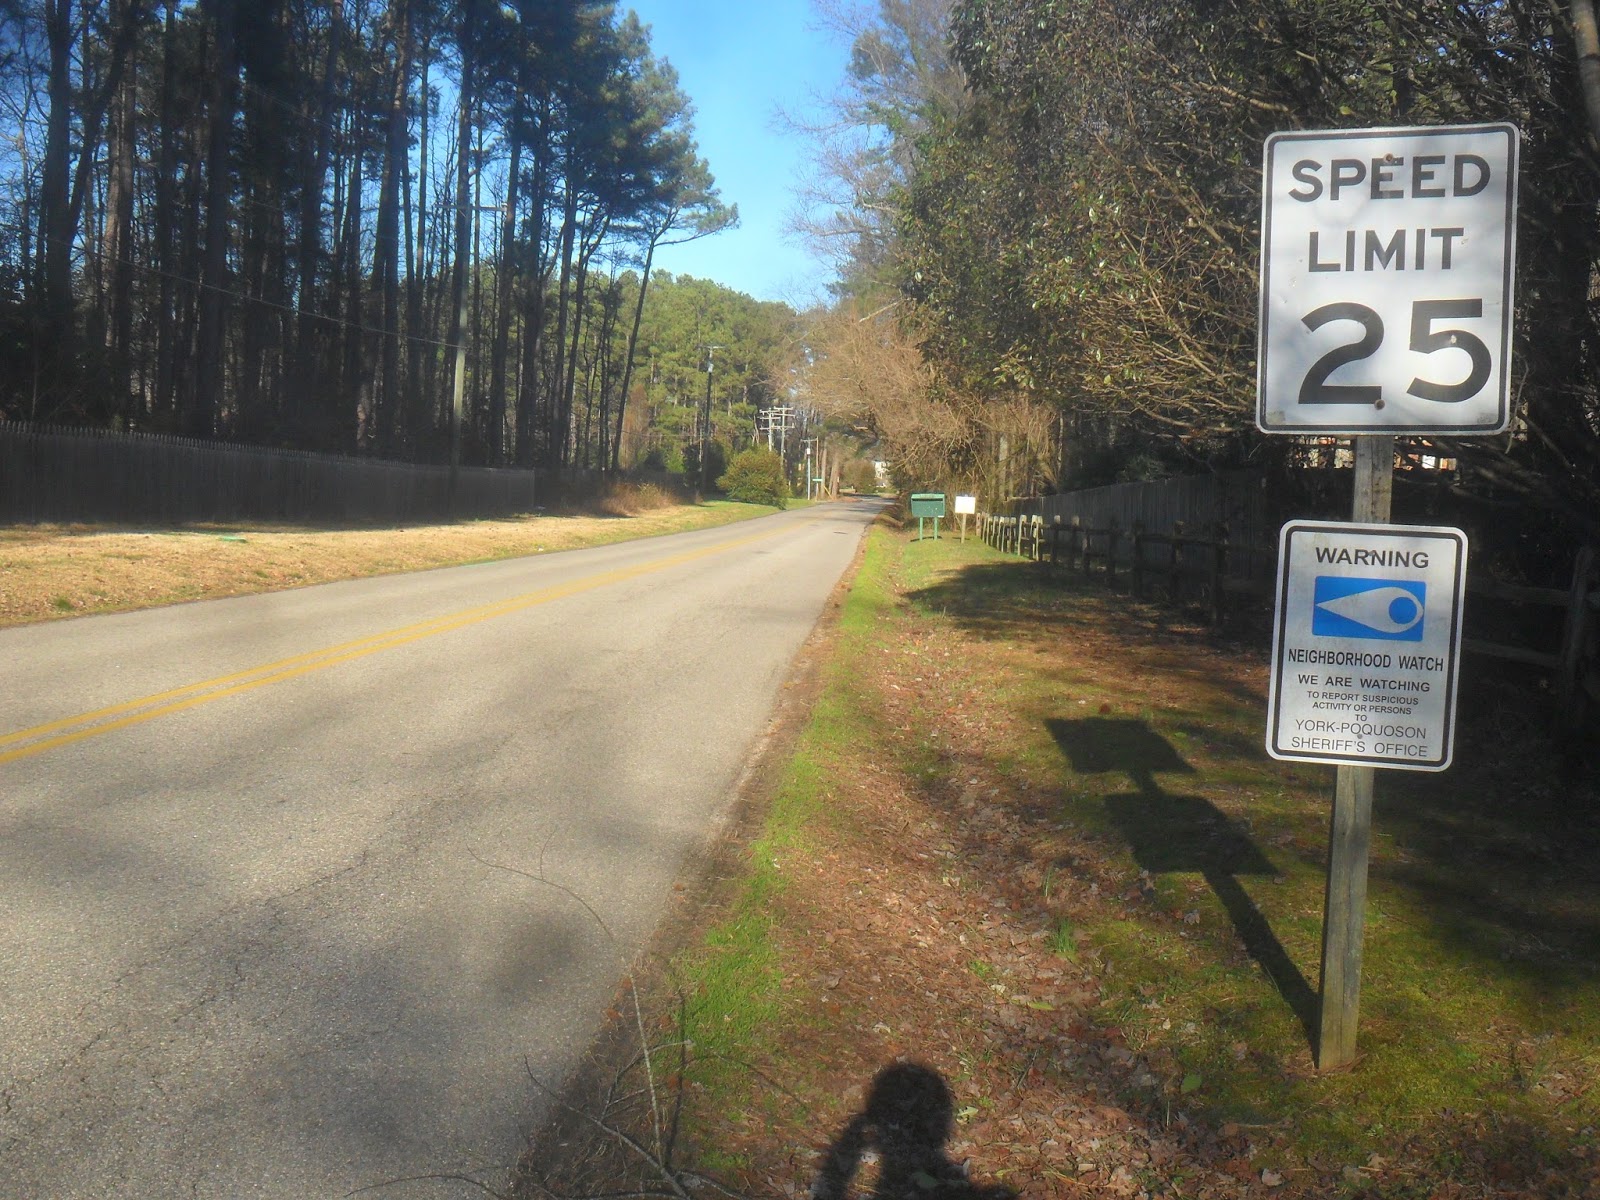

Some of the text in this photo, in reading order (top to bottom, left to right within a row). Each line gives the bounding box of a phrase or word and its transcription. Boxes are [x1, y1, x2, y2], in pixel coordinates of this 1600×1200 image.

[1288, 154, 1491, 202] SPEED
[1308, 227, 1464, 272] LIMIT
[1298, 298, 1491, 404] 25
[1315, 547, 1429, 568] WARNING
[1288, 649, 1444, 671] NEIGHBORHOOD WATCH
[1298, 674, 1430, 692] WE ARE WATCHING
[1307, 691, 1419, 705] TO REPORT SUSPICIOUS
[1312, 702, 1412, 715] ACTIVITY OR PERSONS
[1354, 714, 1367, 722] TO
[1295, 719, 1427, 739] YORK-POQUOSON
[1291, 736, 1428, 757] SHERIFF'S OFFICE
